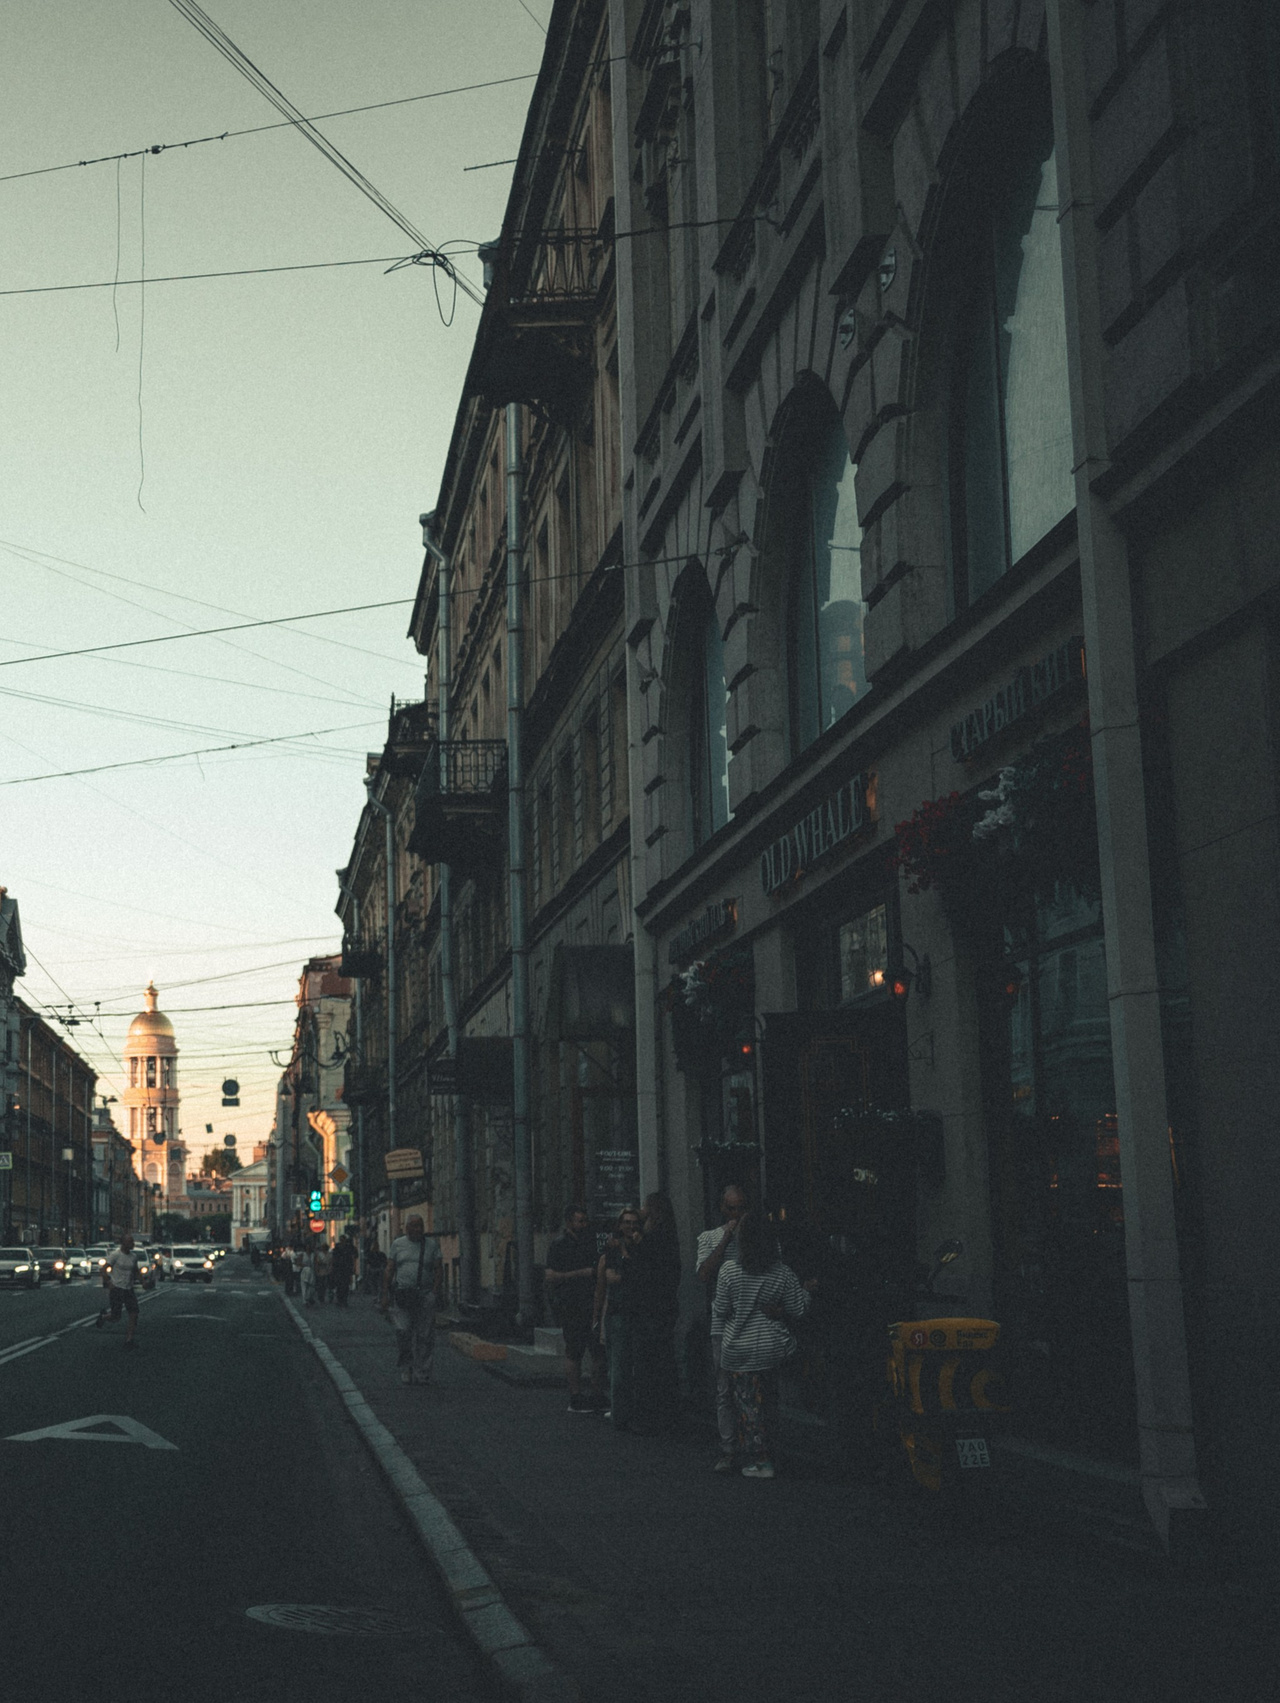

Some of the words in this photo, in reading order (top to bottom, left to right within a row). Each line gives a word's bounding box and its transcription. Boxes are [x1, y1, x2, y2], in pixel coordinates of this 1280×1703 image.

[948, 669, 1026, 762] СТАРЫЙ
[1030, 637, 1072, 705] КИТ
[759, 834, 791, 896] OLD
[793, 773, 864, 870] WHALE
